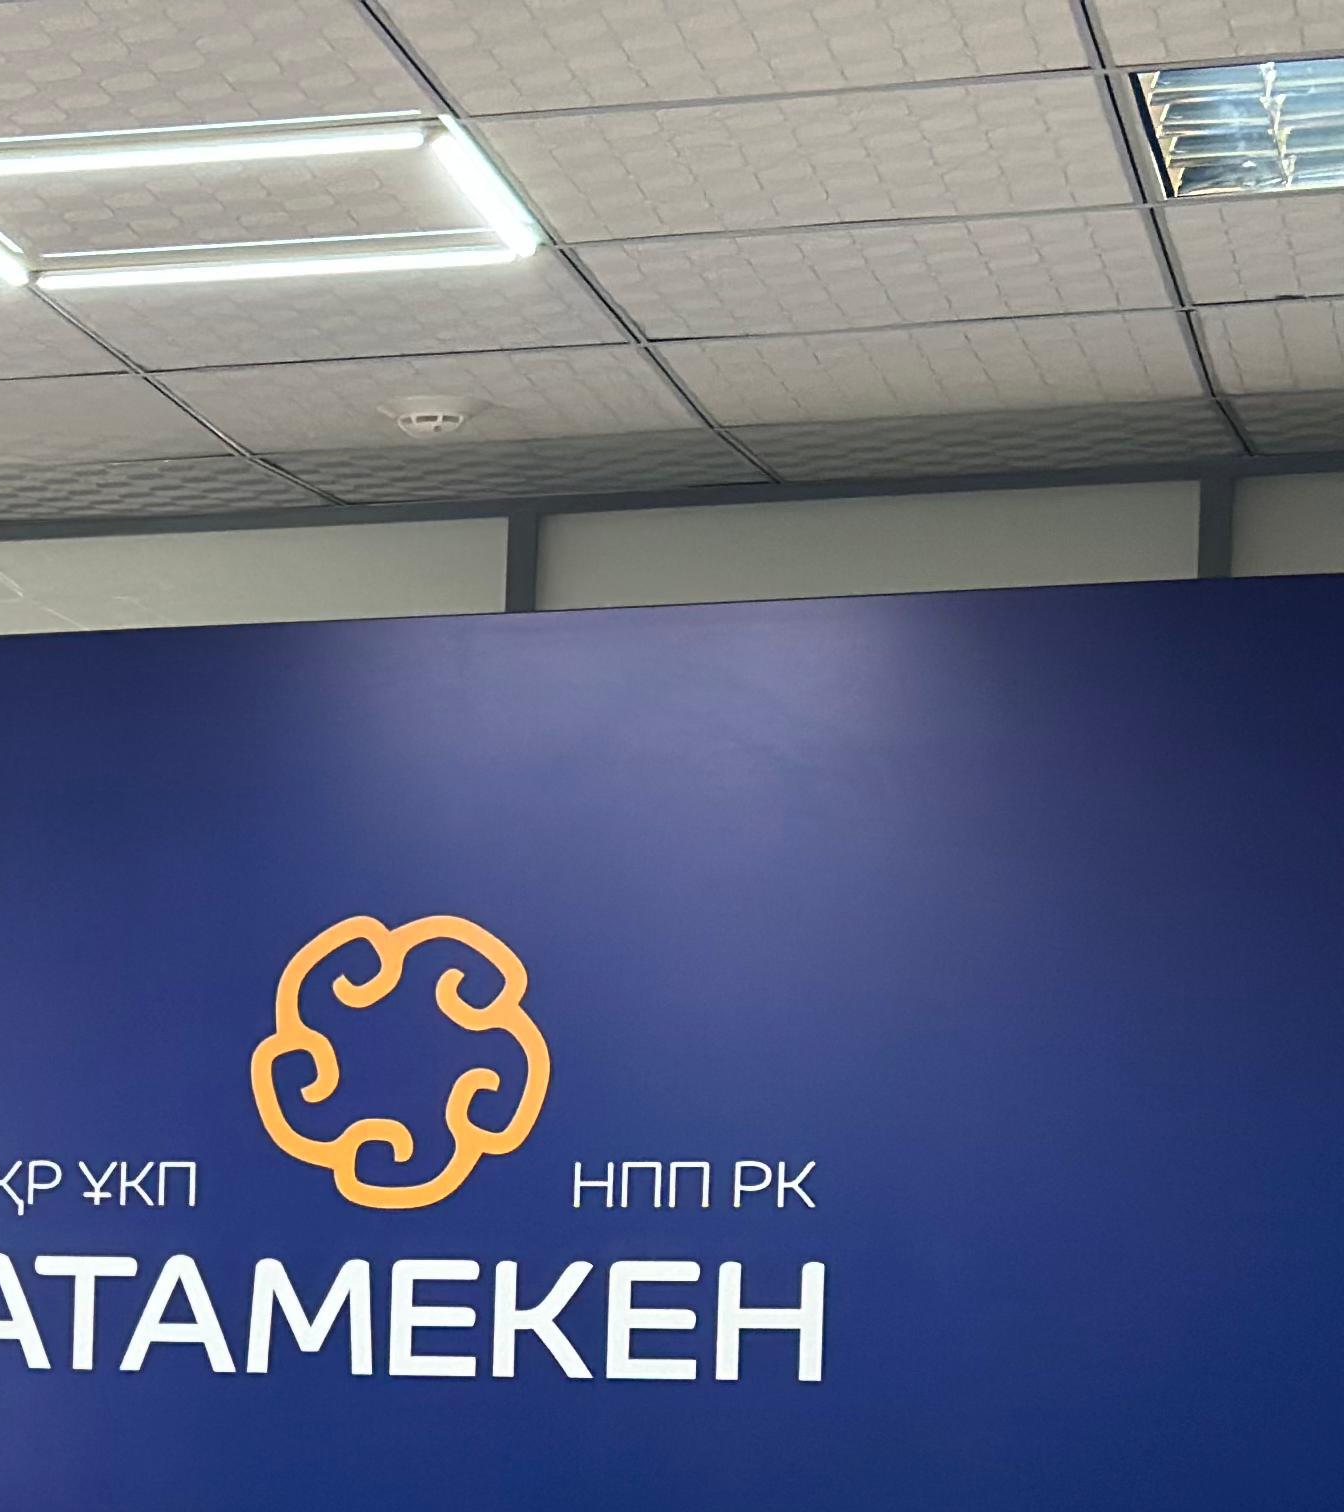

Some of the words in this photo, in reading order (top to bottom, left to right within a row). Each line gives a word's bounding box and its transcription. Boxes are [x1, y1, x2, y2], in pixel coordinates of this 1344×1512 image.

[79, 1160, 197, 1207] ҰКП
[573, 1161, 710, 1208] НПП
[733, 1160, 816, 1208] РК
